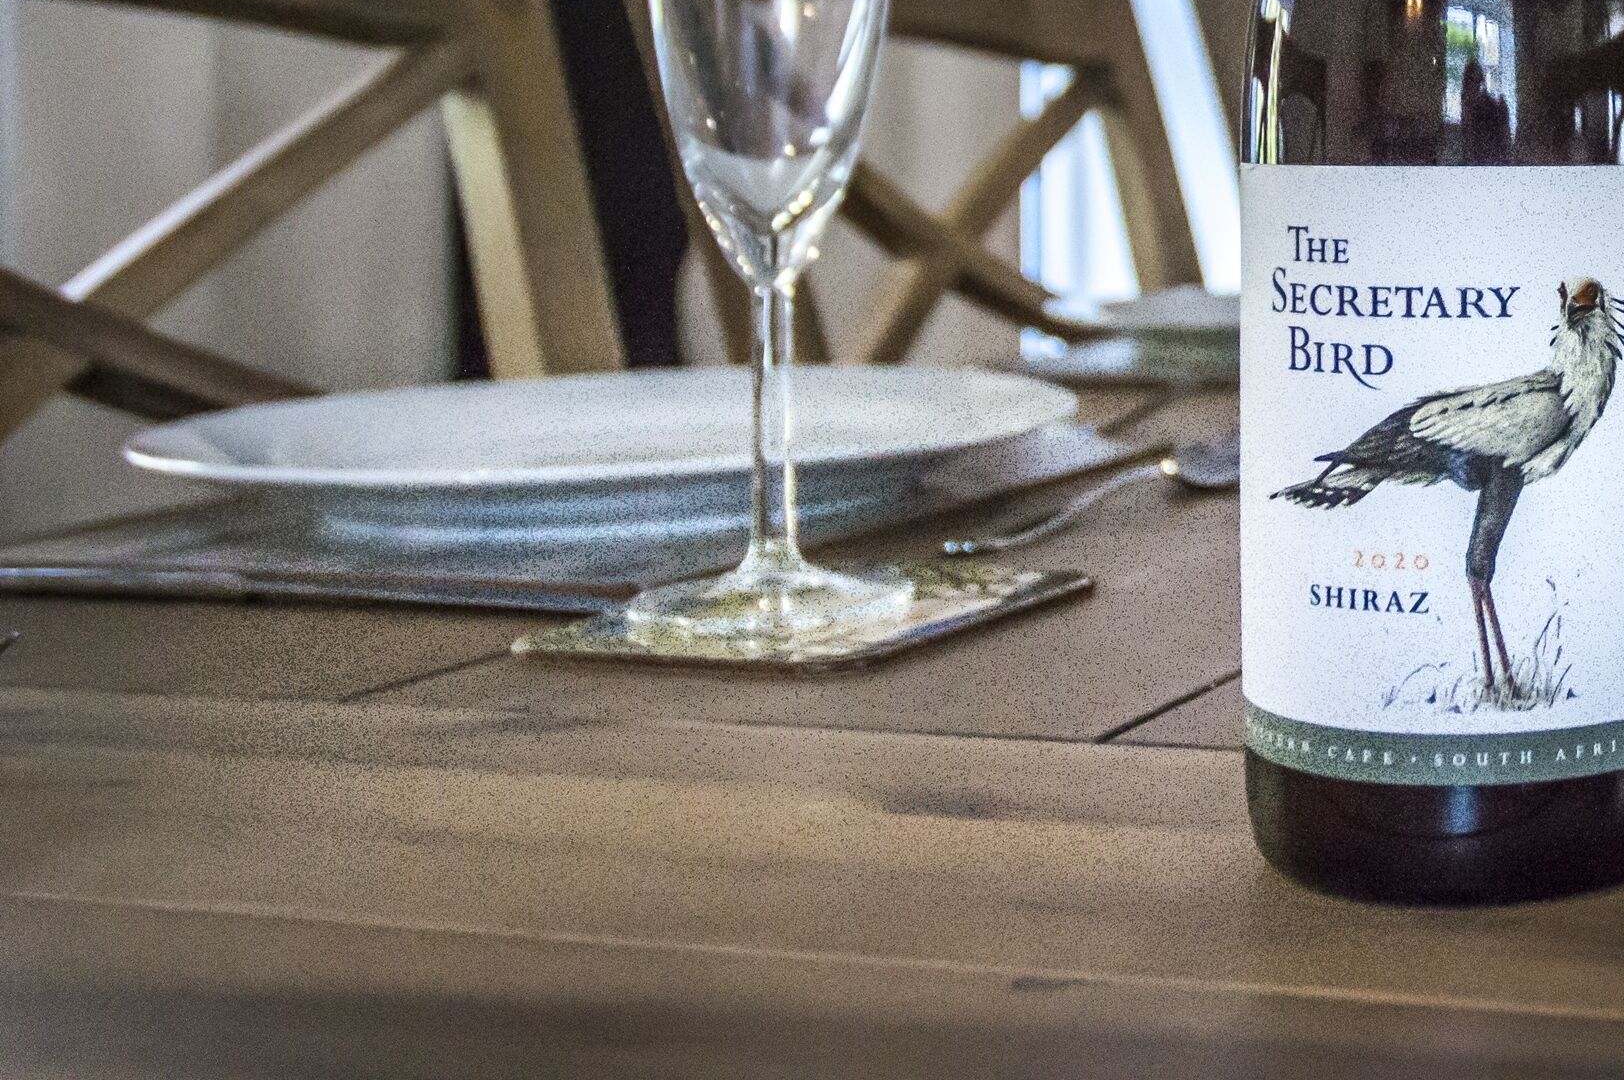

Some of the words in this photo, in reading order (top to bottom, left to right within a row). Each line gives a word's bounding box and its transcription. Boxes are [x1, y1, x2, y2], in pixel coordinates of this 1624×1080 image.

[1287, 224, 1350, 264] THE
[1271, 266, 1521, 319] SECRETARY
[1287, 325, 1394, 391] BIRD
[1353, 549, 1430, 571] 2020
[1309, 583, 1430, 614] SHIRAZ
[1327, 744, 1393, 766] CAPE
[1433, 749, 1533, 768] SOUTH
